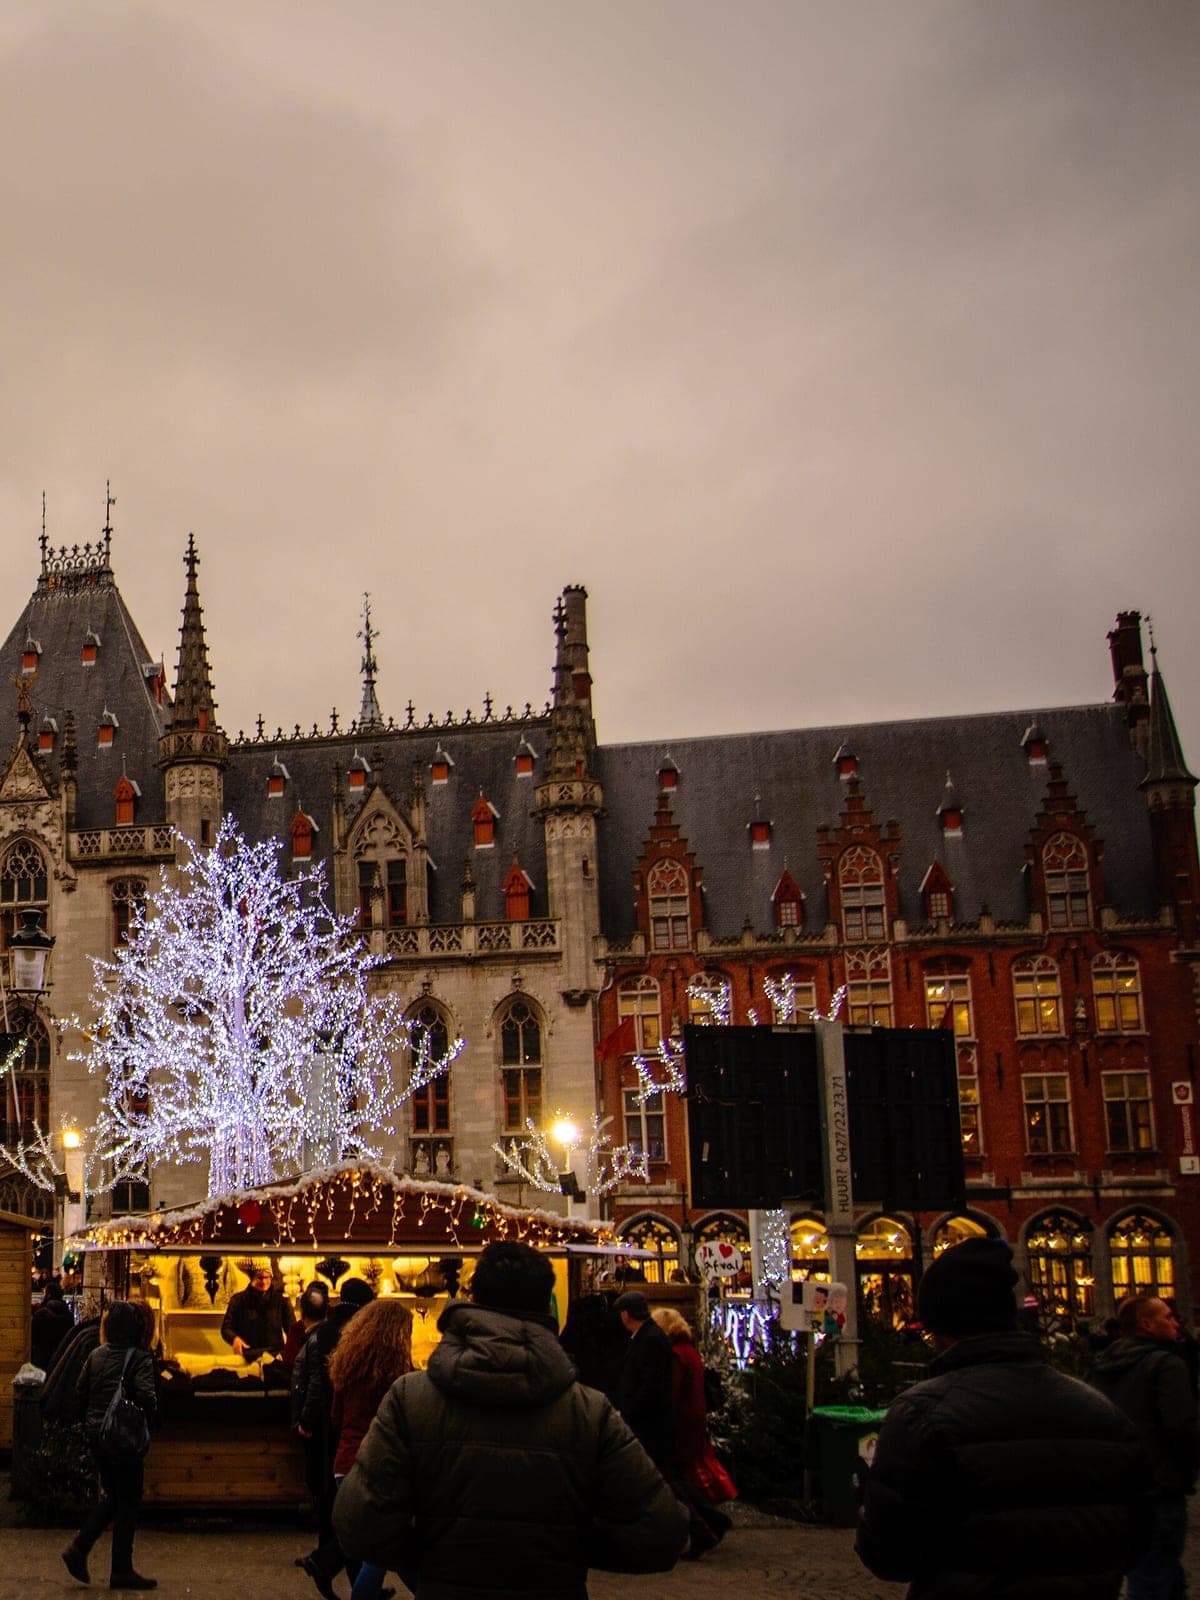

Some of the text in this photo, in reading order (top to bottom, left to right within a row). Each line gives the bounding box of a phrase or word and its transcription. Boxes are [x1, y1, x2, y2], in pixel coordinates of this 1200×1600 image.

[832, 1076, 849, 1213] HUUR? 0477/22.73.71
[704, 1260, 739, 1272] afval
